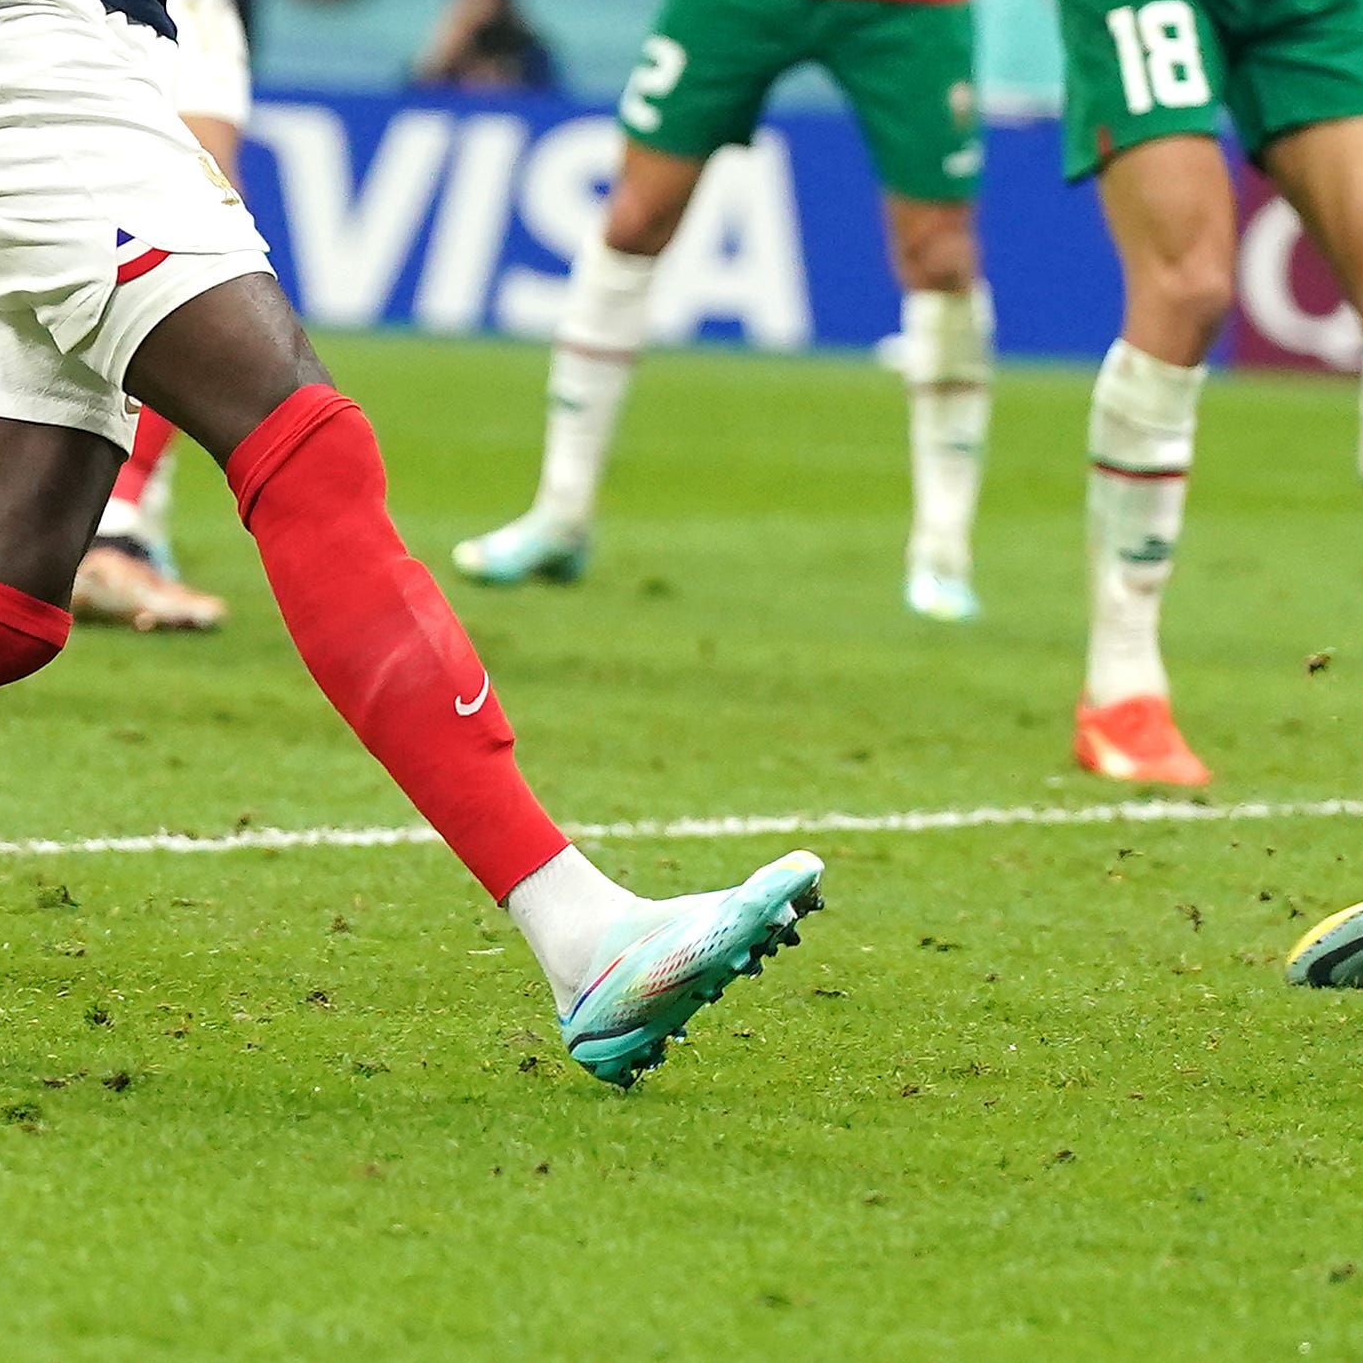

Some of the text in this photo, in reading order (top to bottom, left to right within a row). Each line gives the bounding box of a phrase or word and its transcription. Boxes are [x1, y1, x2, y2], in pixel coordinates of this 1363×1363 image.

[621, 35, 688, 133] 2
[1107, 0, 1210, 115] 18
[243, 101, 816, 351] VISA
